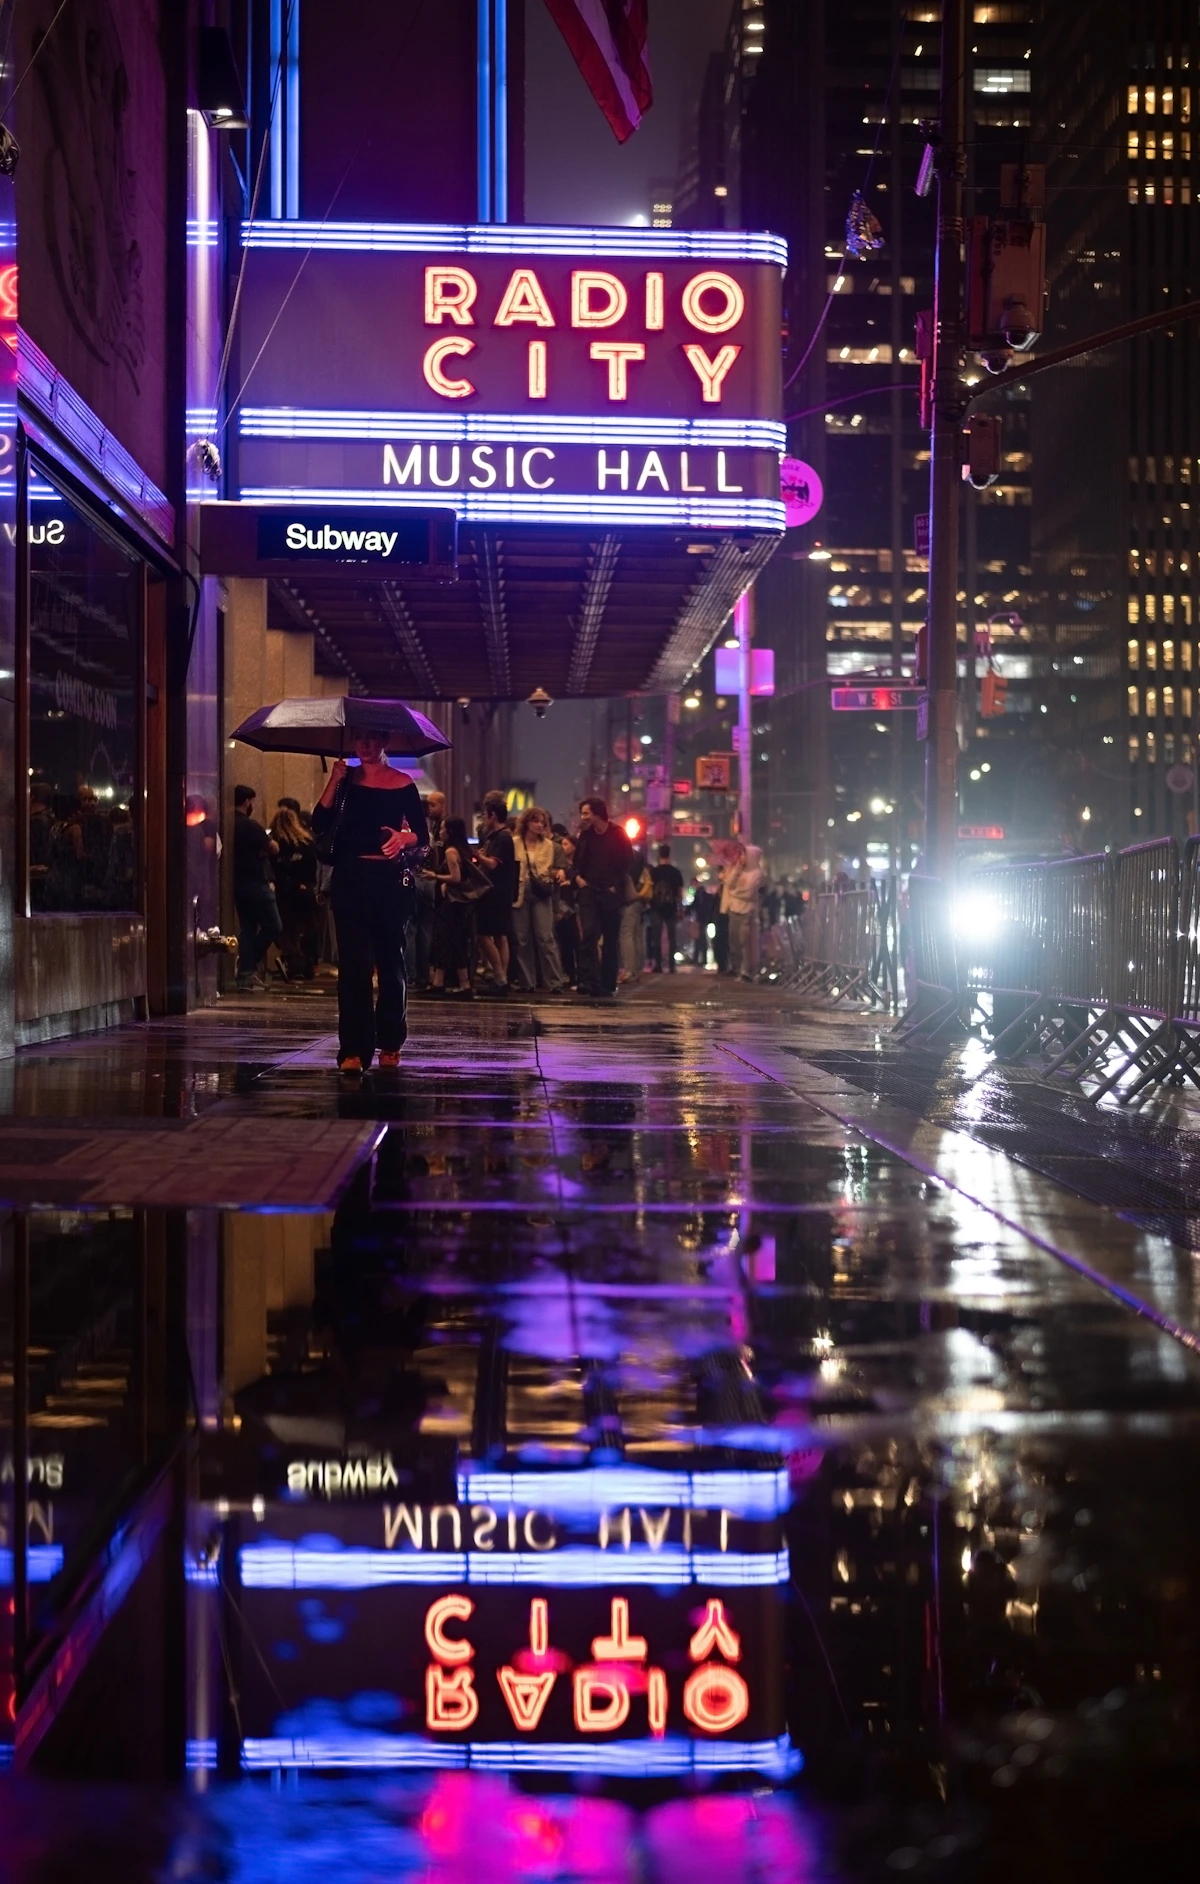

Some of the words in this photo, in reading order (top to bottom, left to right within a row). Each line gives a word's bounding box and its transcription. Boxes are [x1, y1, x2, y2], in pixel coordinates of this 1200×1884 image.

[424, 266, 745, 334] RADIO
[422, 336, 742, 403] CITY
[382, 444, 557, 489] MUSIC
[598, 450, 744, 493] HALL
[286, 523, 399, 557] Subway
[55, 669, 94, 721] COMING
[94, 688, 118, 731] SOON
